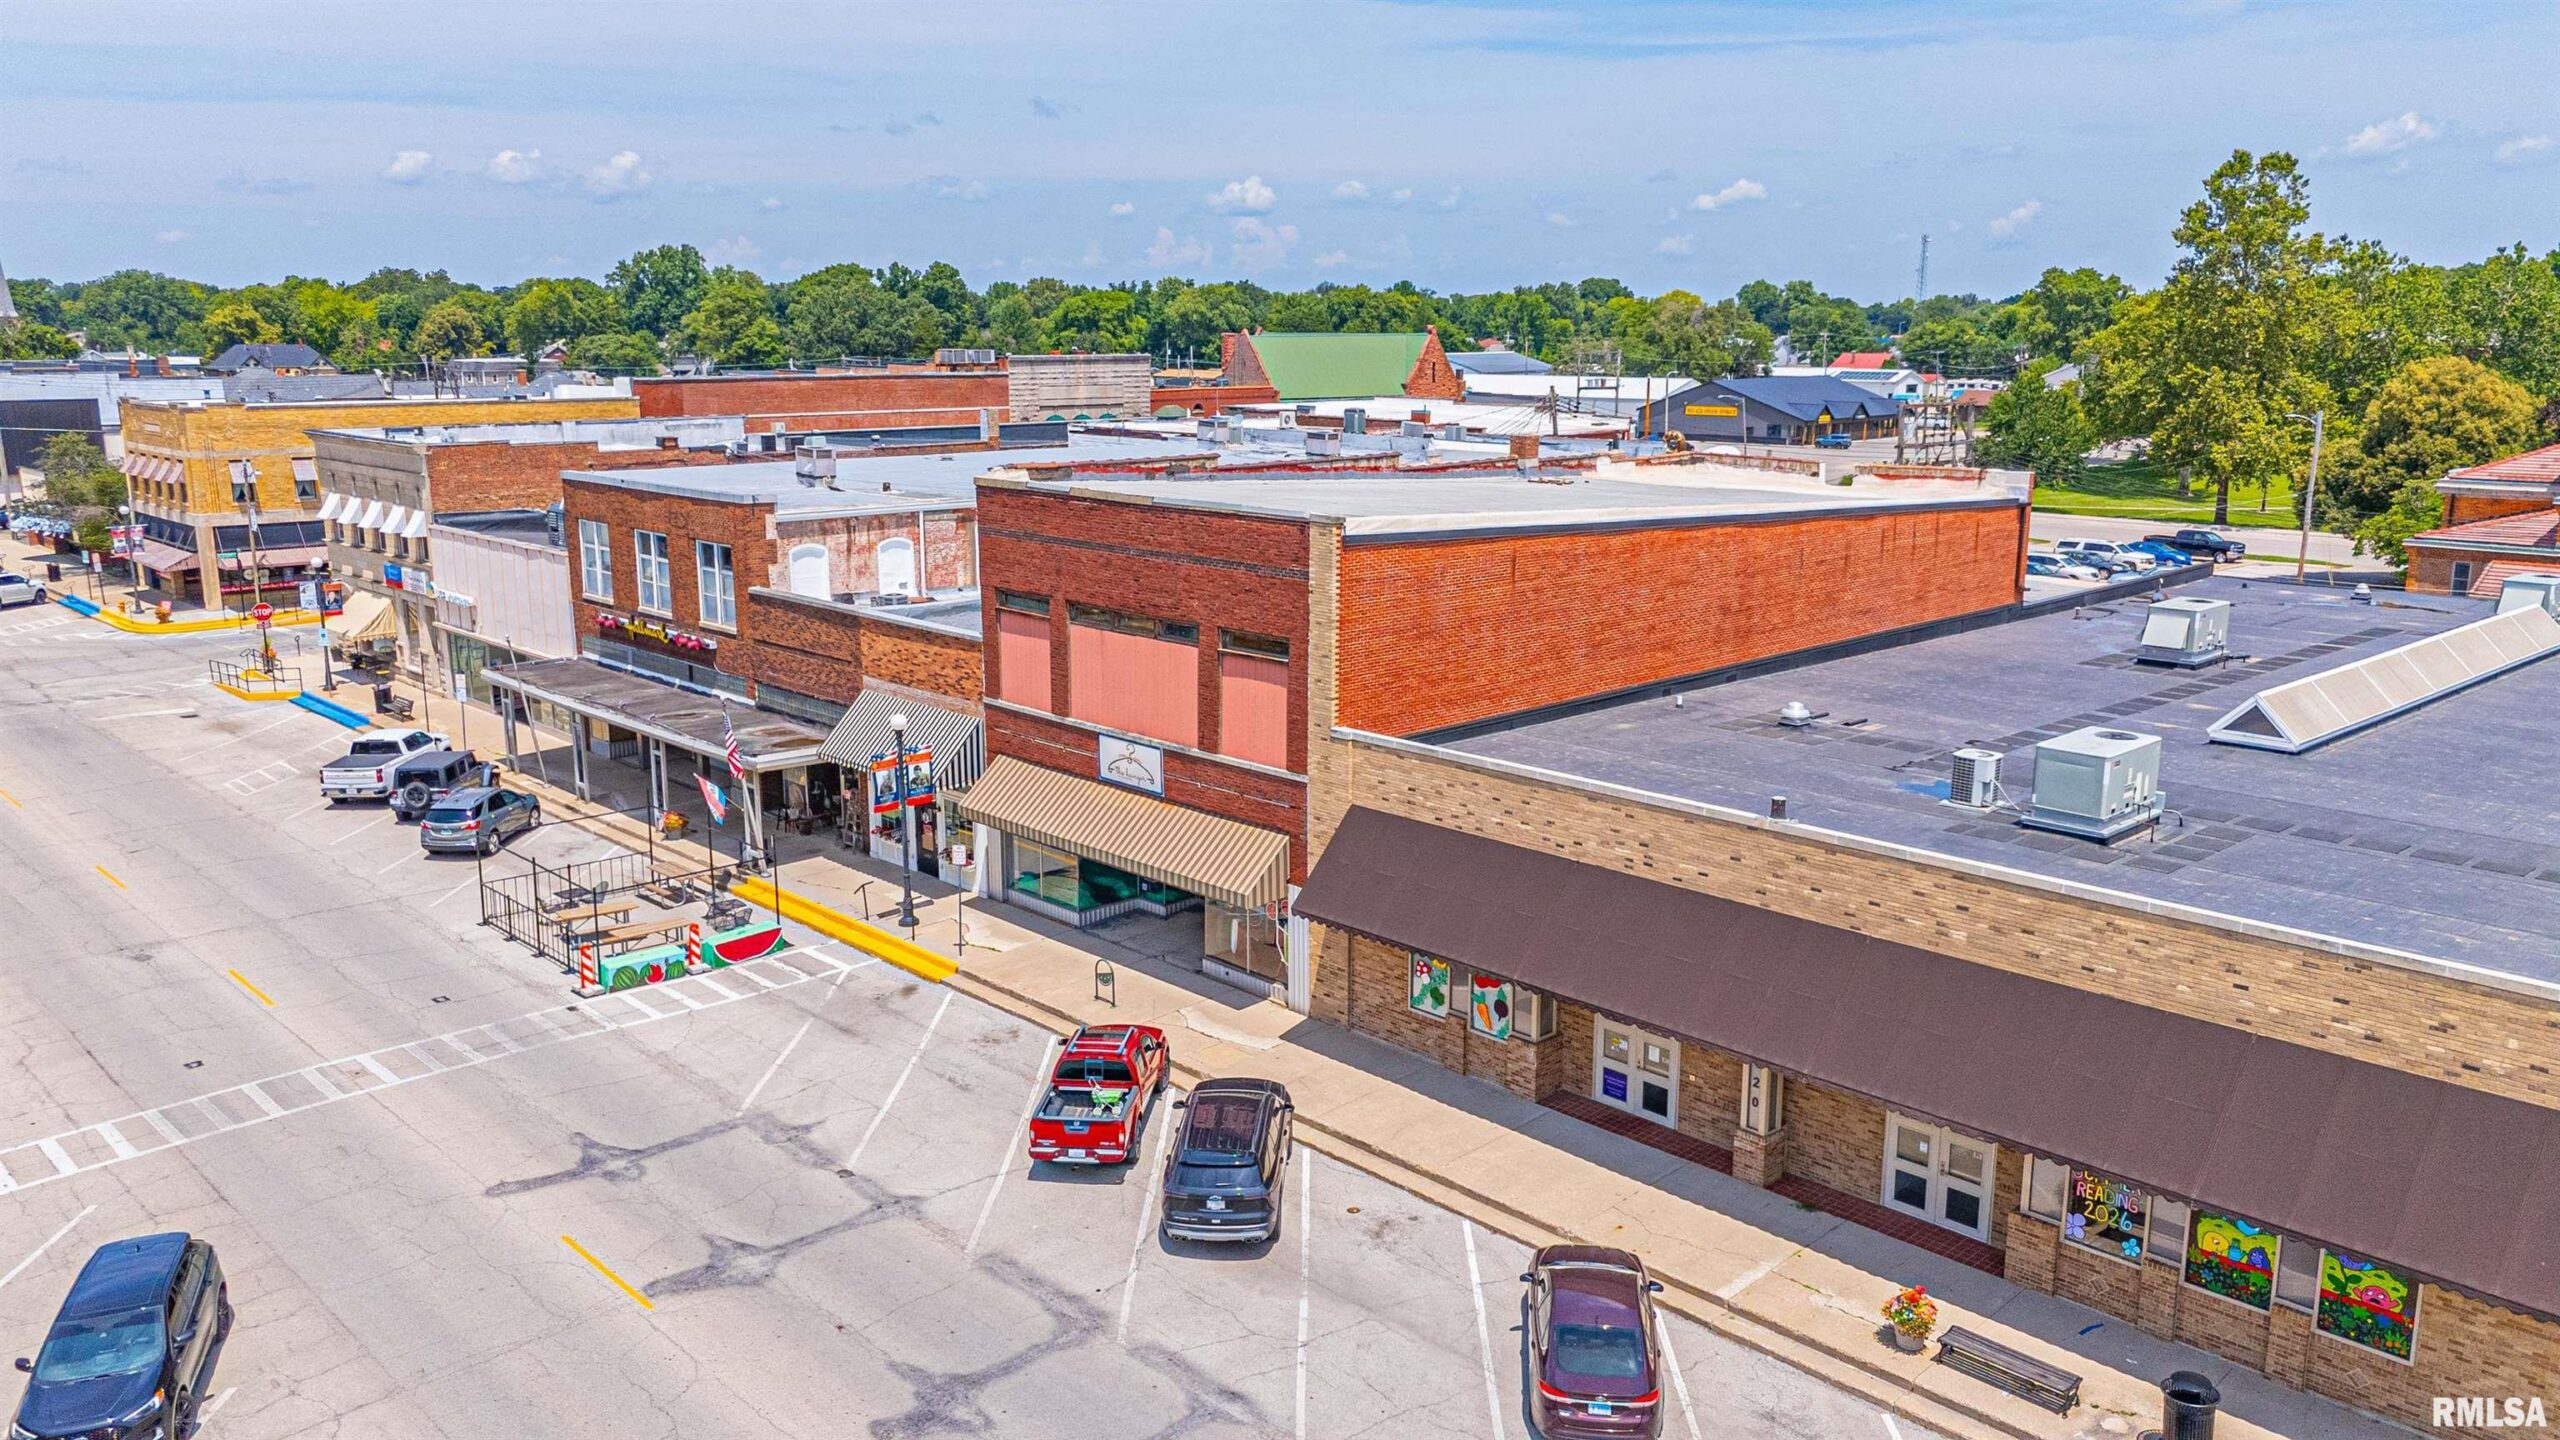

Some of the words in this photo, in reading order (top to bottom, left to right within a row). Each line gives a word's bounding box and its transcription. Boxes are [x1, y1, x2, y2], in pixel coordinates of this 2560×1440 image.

[253, 607, 272, 617] STOP
[2076, 1181, 2139, 1214] READING
[2083, 1200, 2133, 1231] 2026
